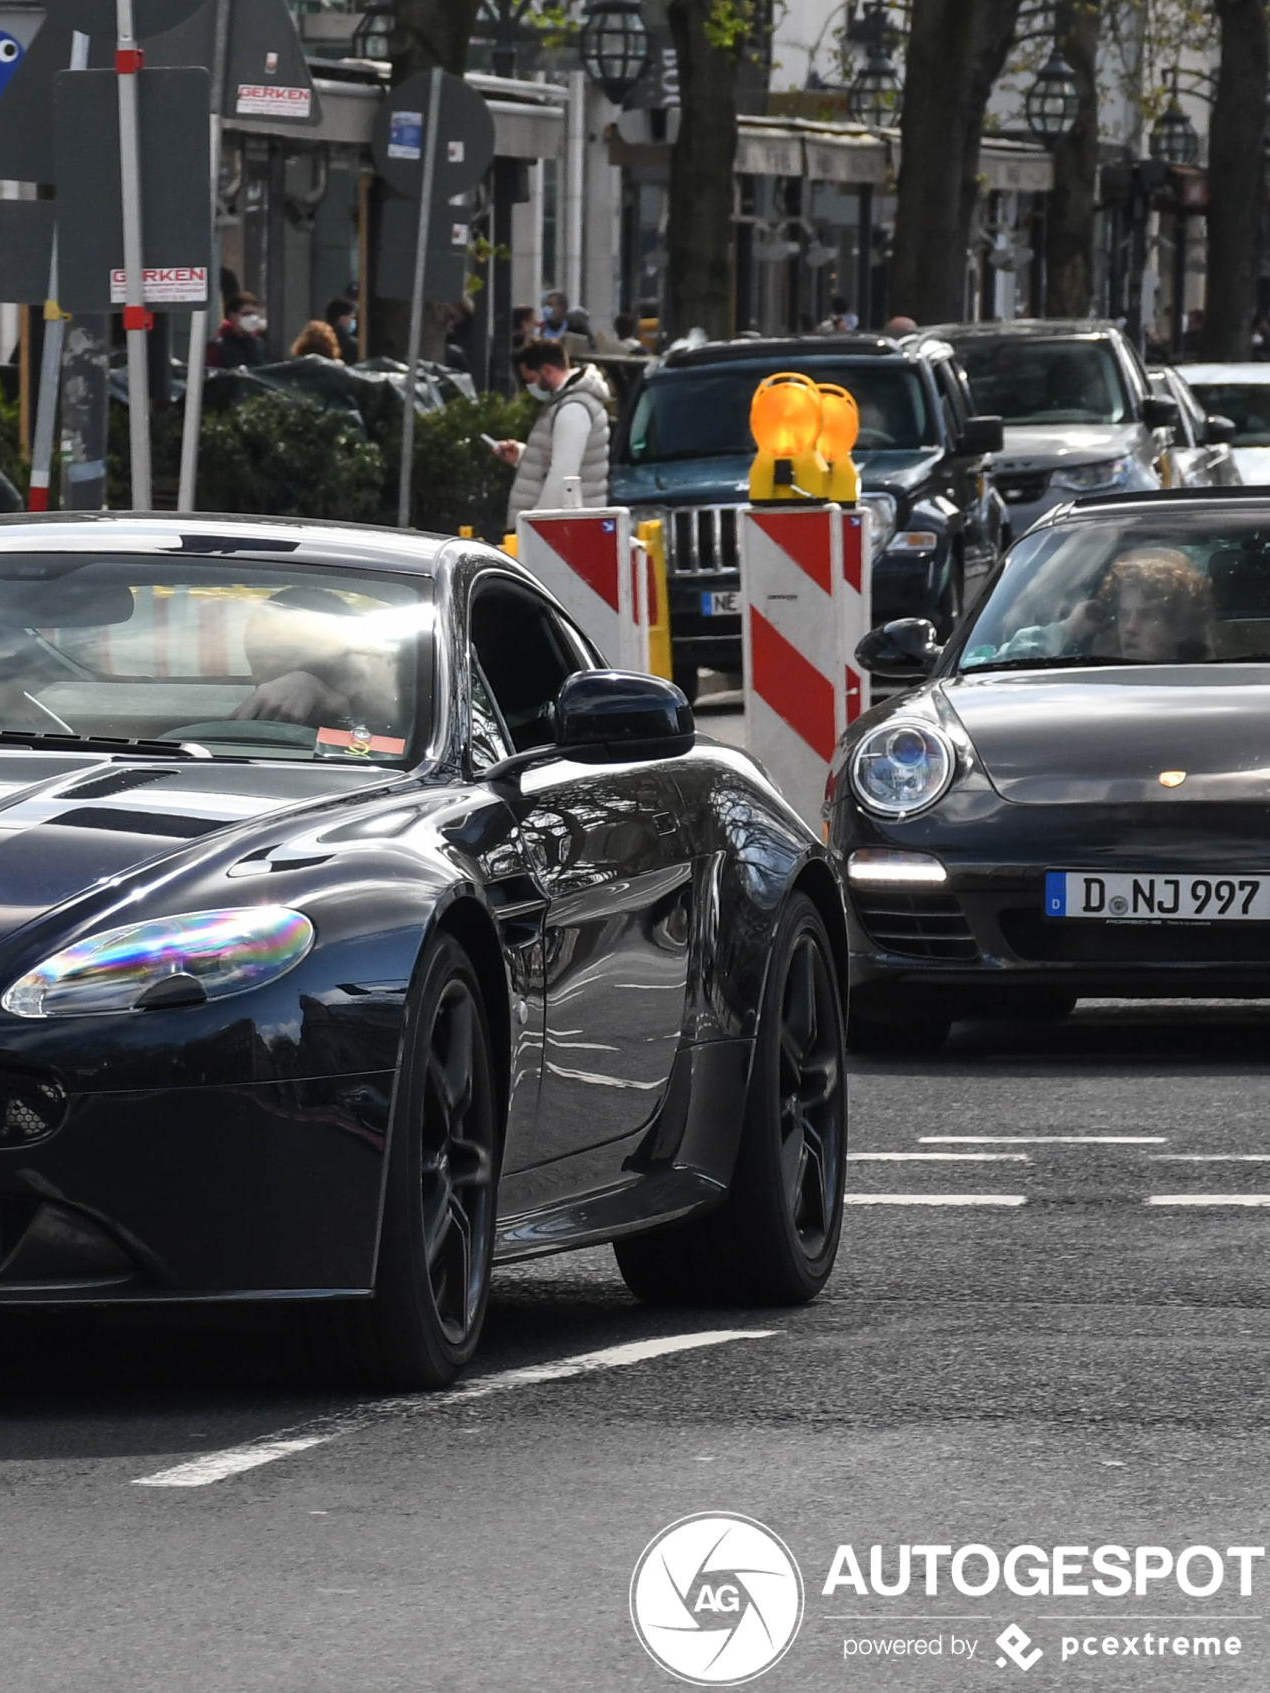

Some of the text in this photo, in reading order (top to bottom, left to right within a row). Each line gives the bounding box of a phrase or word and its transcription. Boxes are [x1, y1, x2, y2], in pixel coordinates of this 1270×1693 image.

[239, 86, 310, 100] GERKEN
[112, 268, 205, 283] GRKEN
[1082, 877, 1260, 915] D NJ 997
[1051, 898, 1061, 910] D
